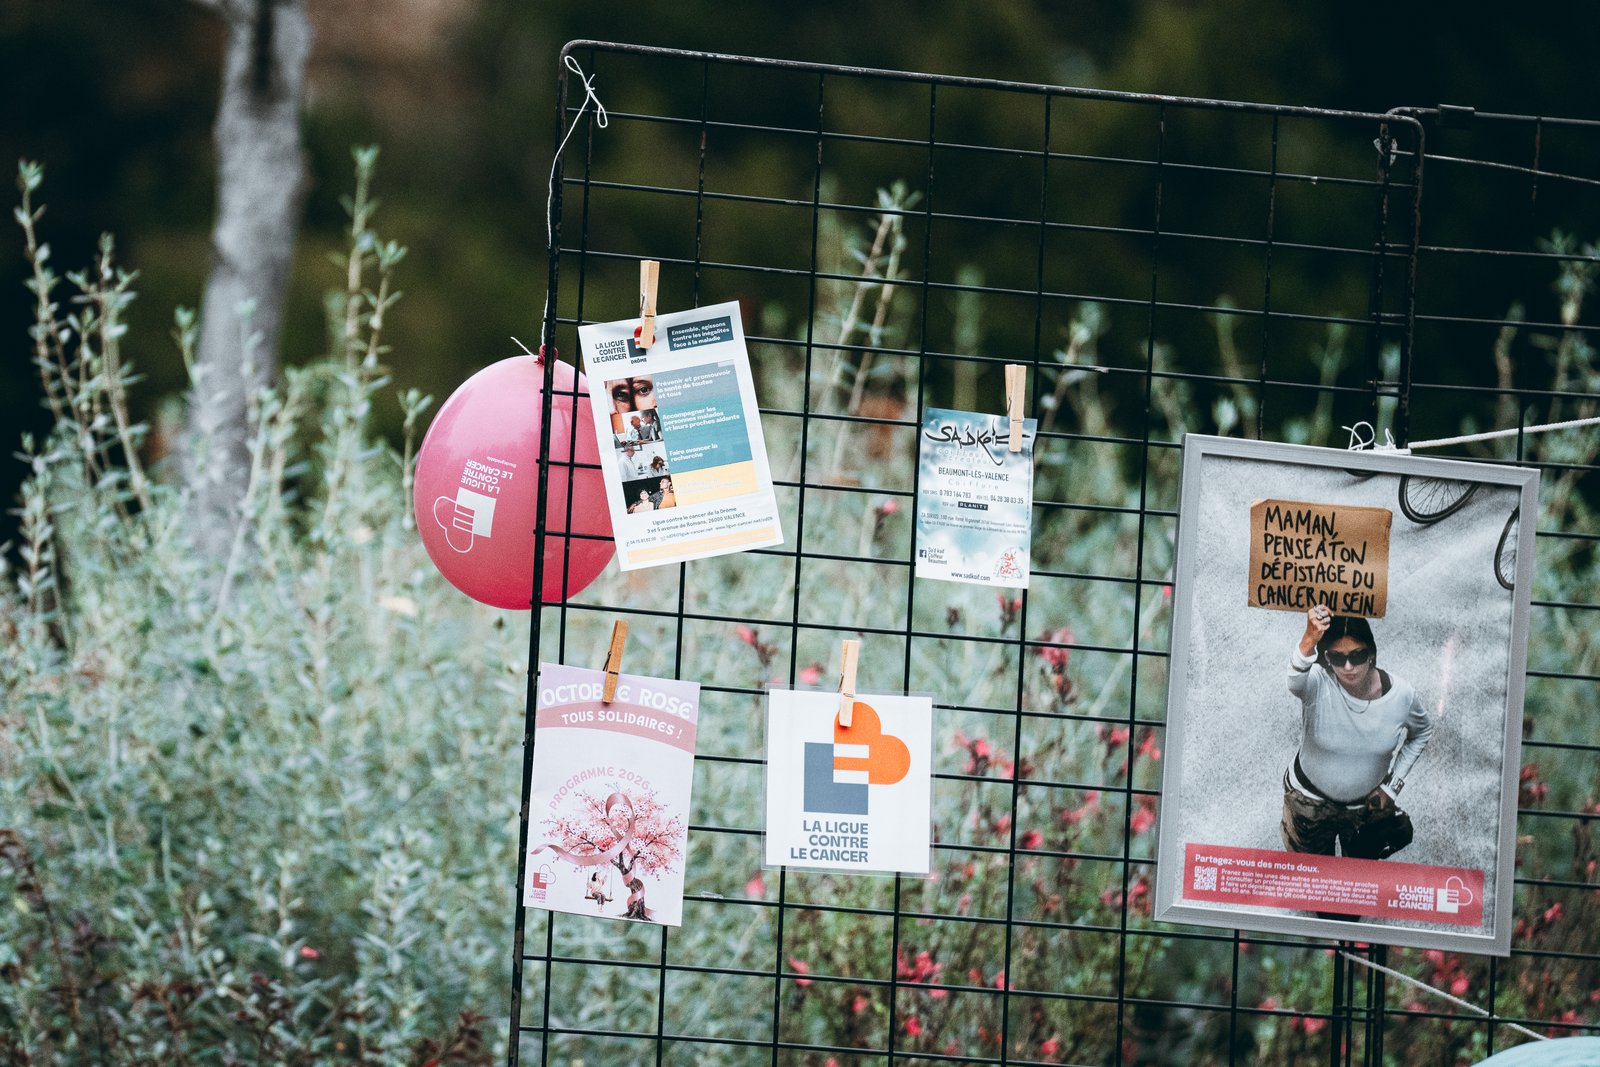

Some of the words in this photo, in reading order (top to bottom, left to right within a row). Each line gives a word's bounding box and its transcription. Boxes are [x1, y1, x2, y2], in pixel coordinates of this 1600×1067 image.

[671, 327, 700, 336] Ensemble,
[701, 321, 726, 331] agissons
[672, 333, 692, 342] contre
[702, 327, 730, 338] inégalités
[595, 342, 605, 350] LA
[605, 340, 625, 348] LIGUE
[698, 336, 721, 344] maladie
[599, 347, 626, 356] CONTRE
[601, 353, 627, 363] CANCER
[656, 378, 684, 387] Prévenir
[693, 370, 730, 382] promouvoir
[663, 408, 706, 420] Accompagner
[664, 417, 696, 427] personnes
[689, 420, 716, 429] proches
[716, 414, 740, 422] aidants
[686, 445, 711, 454] avancer
[671, 452, 704, 462] recherche
[466, 459, 500, 476] CANCER
[463, 466, 499, 484] CONTRE
[501, 470, 513, 480] LE
[461, 476, 486, 490] LIGUE
[488, 485, 500, 494] LA
[686, 520, 708, 528] Romans,
[724, 512, 746, 520] VALENCE
[1264, 505, 1338, 540] MAMAN,
[1264, 533, 1314, 560] PENSE
[1328, 541, 1367, 565] TON
[951, 571, 991, 581] www.sadkoif.com
[1352, 570, 1374, 590] DU
[1258, 584, 1318, 608] CANCER
[1320, 590, 1338, 612] DU
[541, 682, 631, 706] OCTOBE
[638, 688, 694, 719] ROSE
[562, 711, 594, 725] TOUS
[598, 710, 675, 736] SOLIDAIRES
[676, 729, 682, 739] !
[550, 766, 614, 810] PROGRAMME
[618, 768, 650, 791] 2026
[803, 820, 822, 832] LA
[826, 822, 868, 834] LIGUE
[808, 834, 868, 848] CONTRE
[790, 848, 806, 860] LE
[810, 849, 868, 862] CANCER
[1195, 854, 1256, 867] Partagez-vous
[1257, 860, 1272, 869] des
[1274, 863, 1294, 872] mots
[1296, 864, 1320, 873] doux.
[1248, 883, 1276, 892] dépistage
[1396, 884, 1408, 892] LA
[1409, 886, 1434, 895] LIGUE
[1388, 900, 1398, 908] LE
[1399, 901, 1434, 911] CANCER
[1399, 894, 1434, 903] CONTRE
